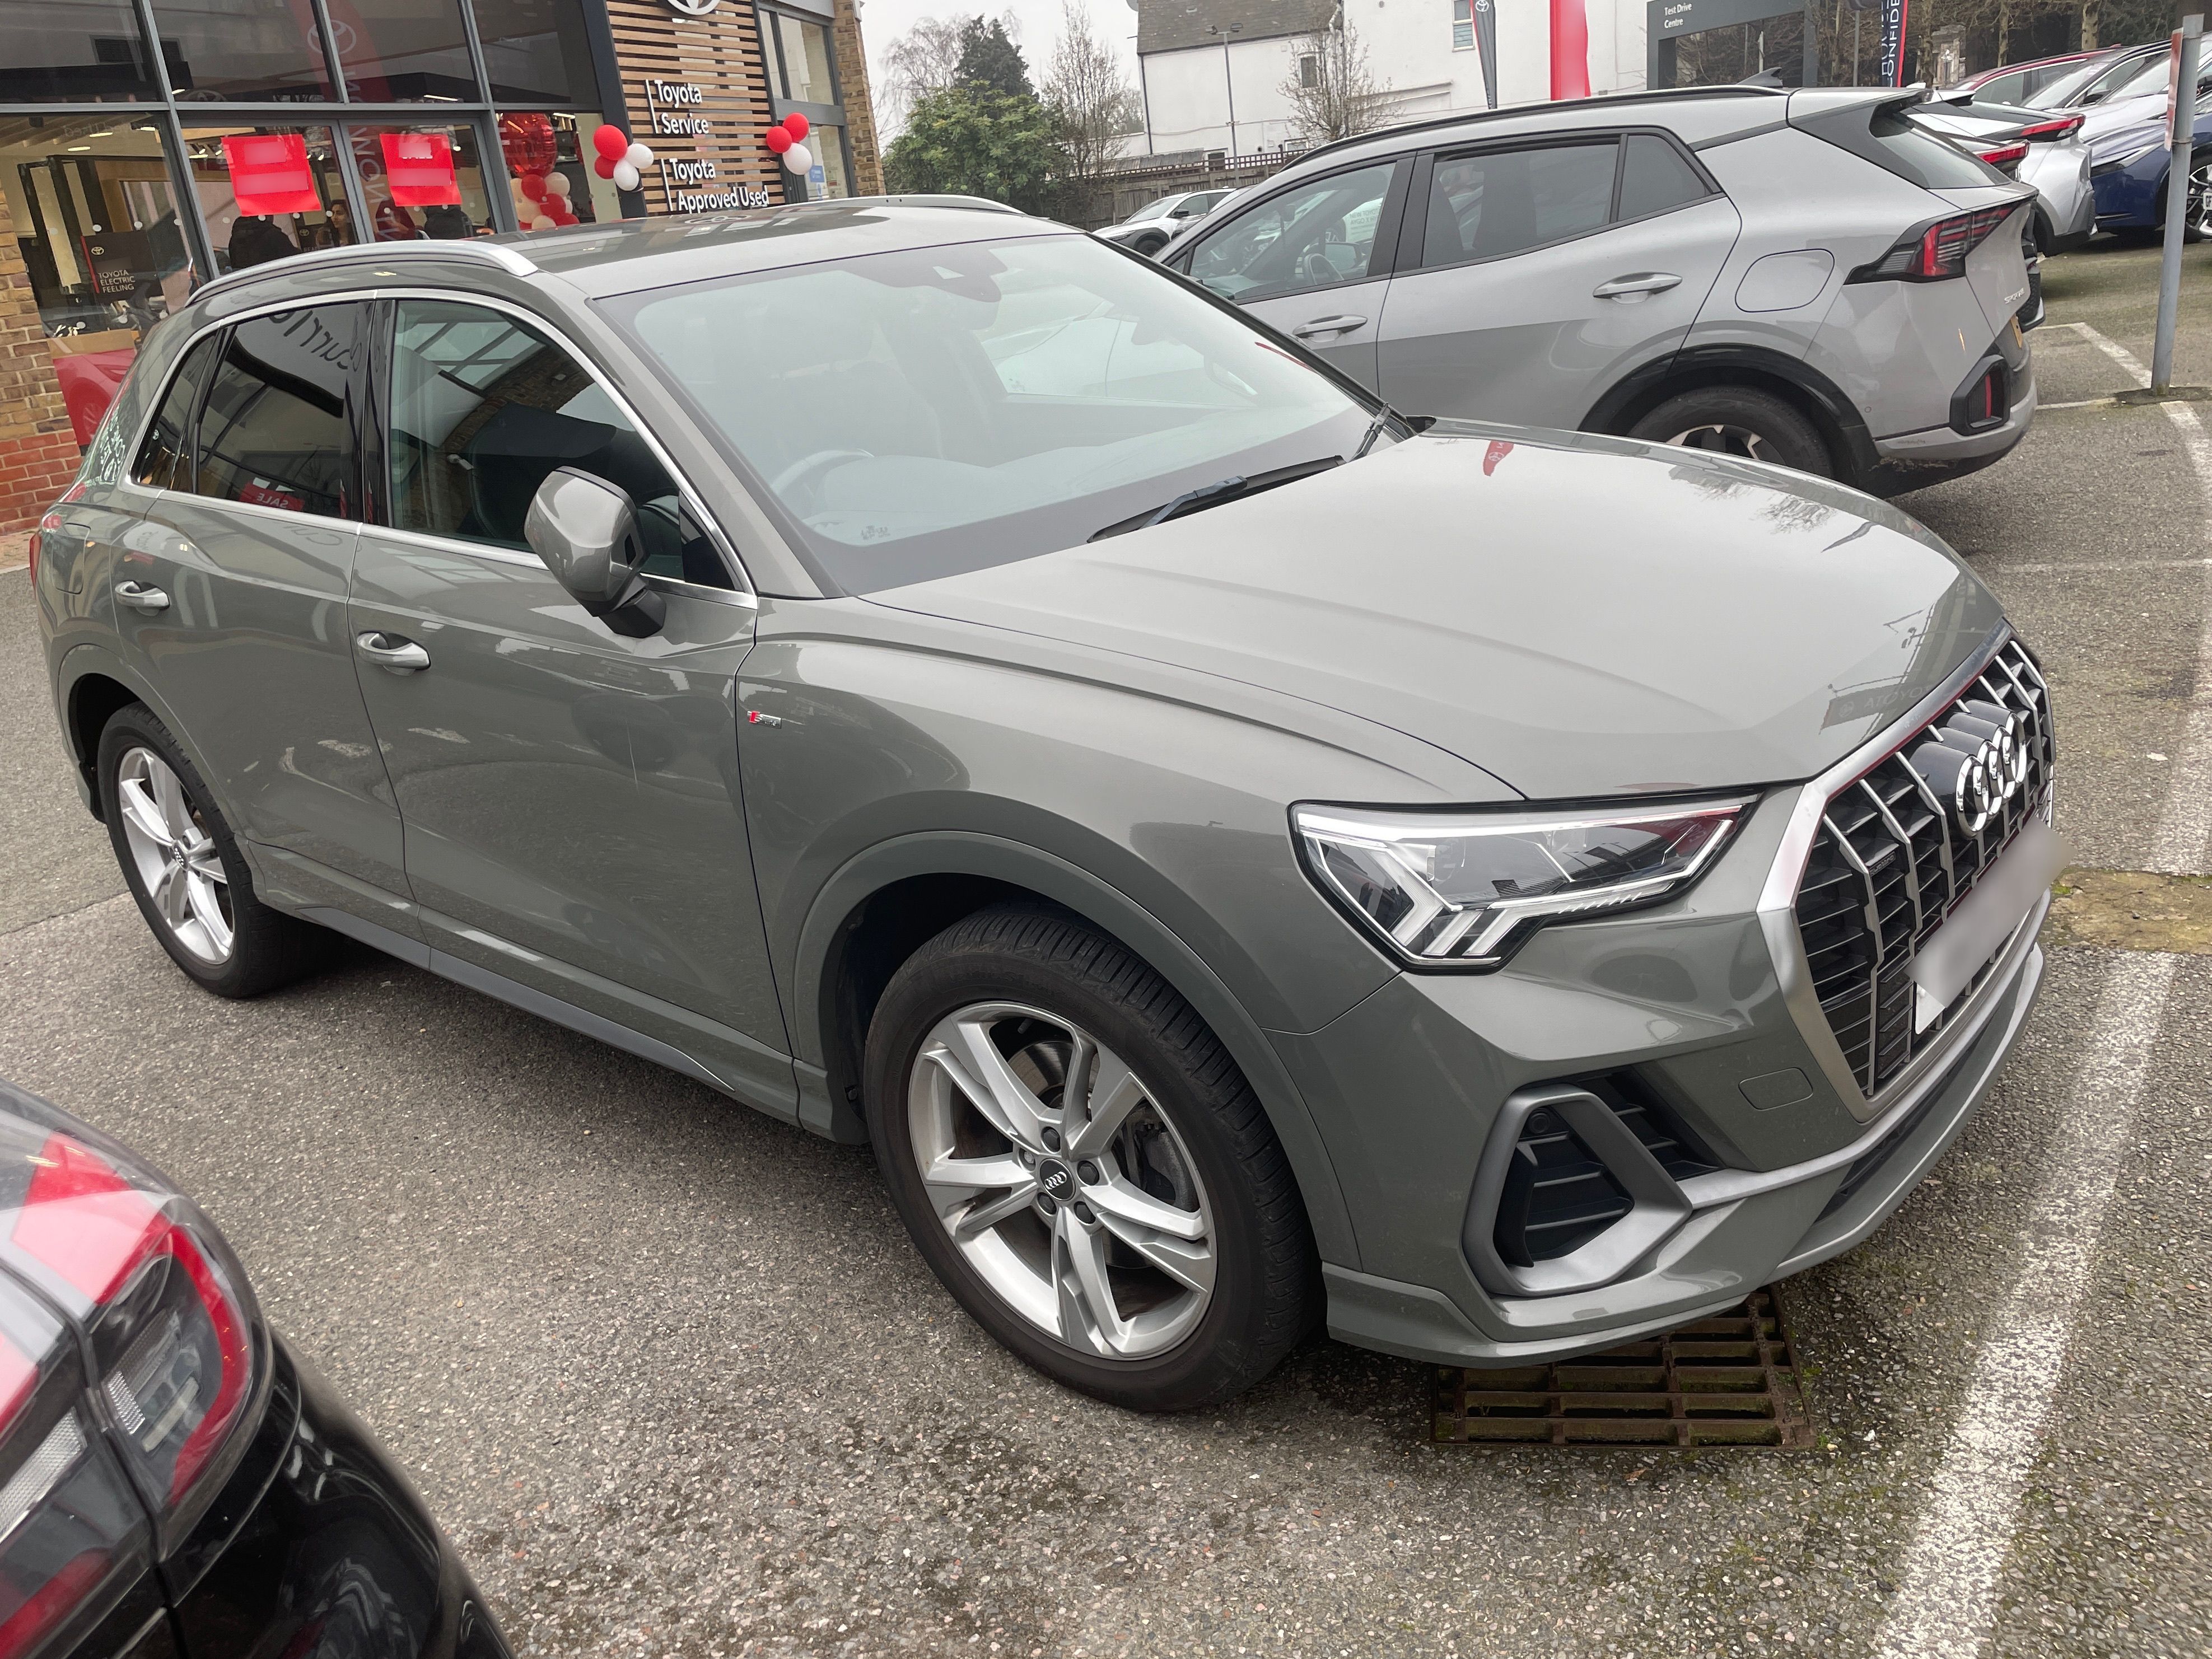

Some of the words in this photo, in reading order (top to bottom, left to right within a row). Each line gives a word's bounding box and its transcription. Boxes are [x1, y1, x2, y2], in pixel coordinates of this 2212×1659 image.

[1664, 7, 1676, 16] Test
[1677, 3, 1692, 13] Drive
[1664, 18, 1683, 28] Centre
[654, 80, 702, 108] Toyota
[661, 113, 709, 134] Service
[669, 158, 716, 185] Toyota
[678, 186, 739, 214] Approved
[739, 185, 769, 206] Used
[98, 270, 129, 279] TOYOTA
[100, 276, 136, 286] ELECTRIC
[102, 284, 134, 293] FEELING
